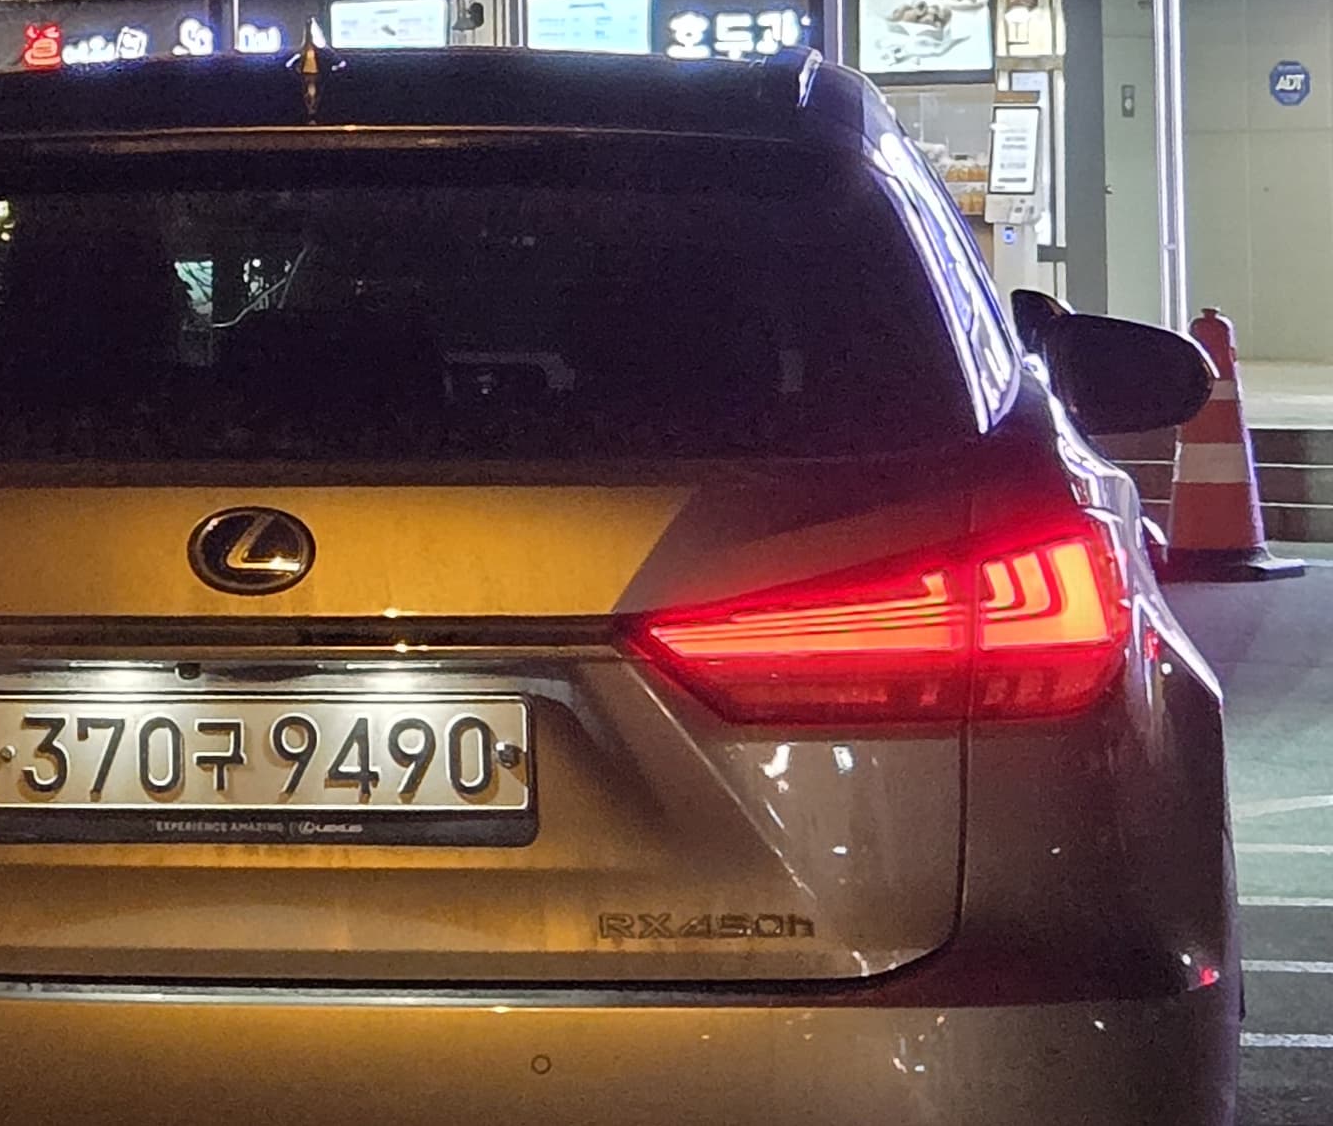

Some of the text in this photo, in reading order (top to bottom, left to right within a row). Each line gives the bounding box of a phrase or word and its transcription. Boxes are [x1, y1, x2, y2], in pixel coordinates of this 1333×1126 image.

[666, 9, 812, 61] 호두과
[1275, 74, 1305, 91] ADT
[21, 712, 495, 801] 370구 9490
[155, 820, 228, 832] EXPERIENCE
